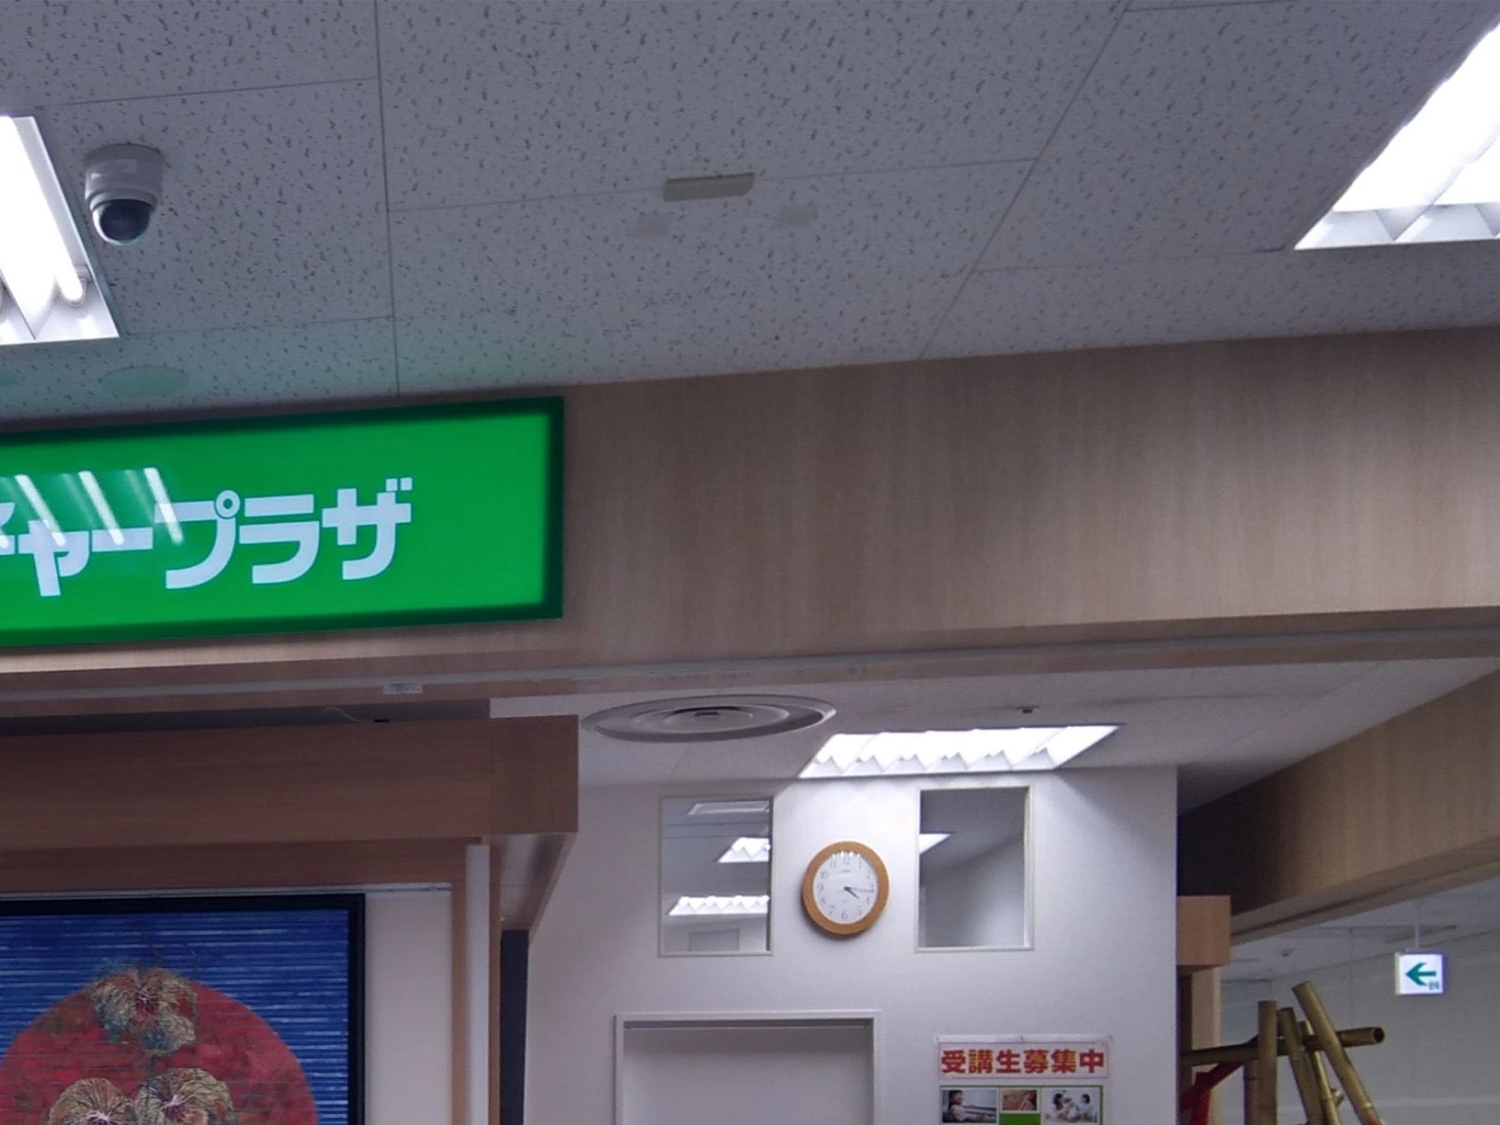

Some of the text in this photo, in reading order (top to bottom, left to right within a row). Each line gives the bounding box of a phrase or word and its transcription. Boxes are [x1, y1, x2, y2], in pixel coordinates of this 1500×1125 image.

[941, 1048, 1105, 1075] 受講生募集中
